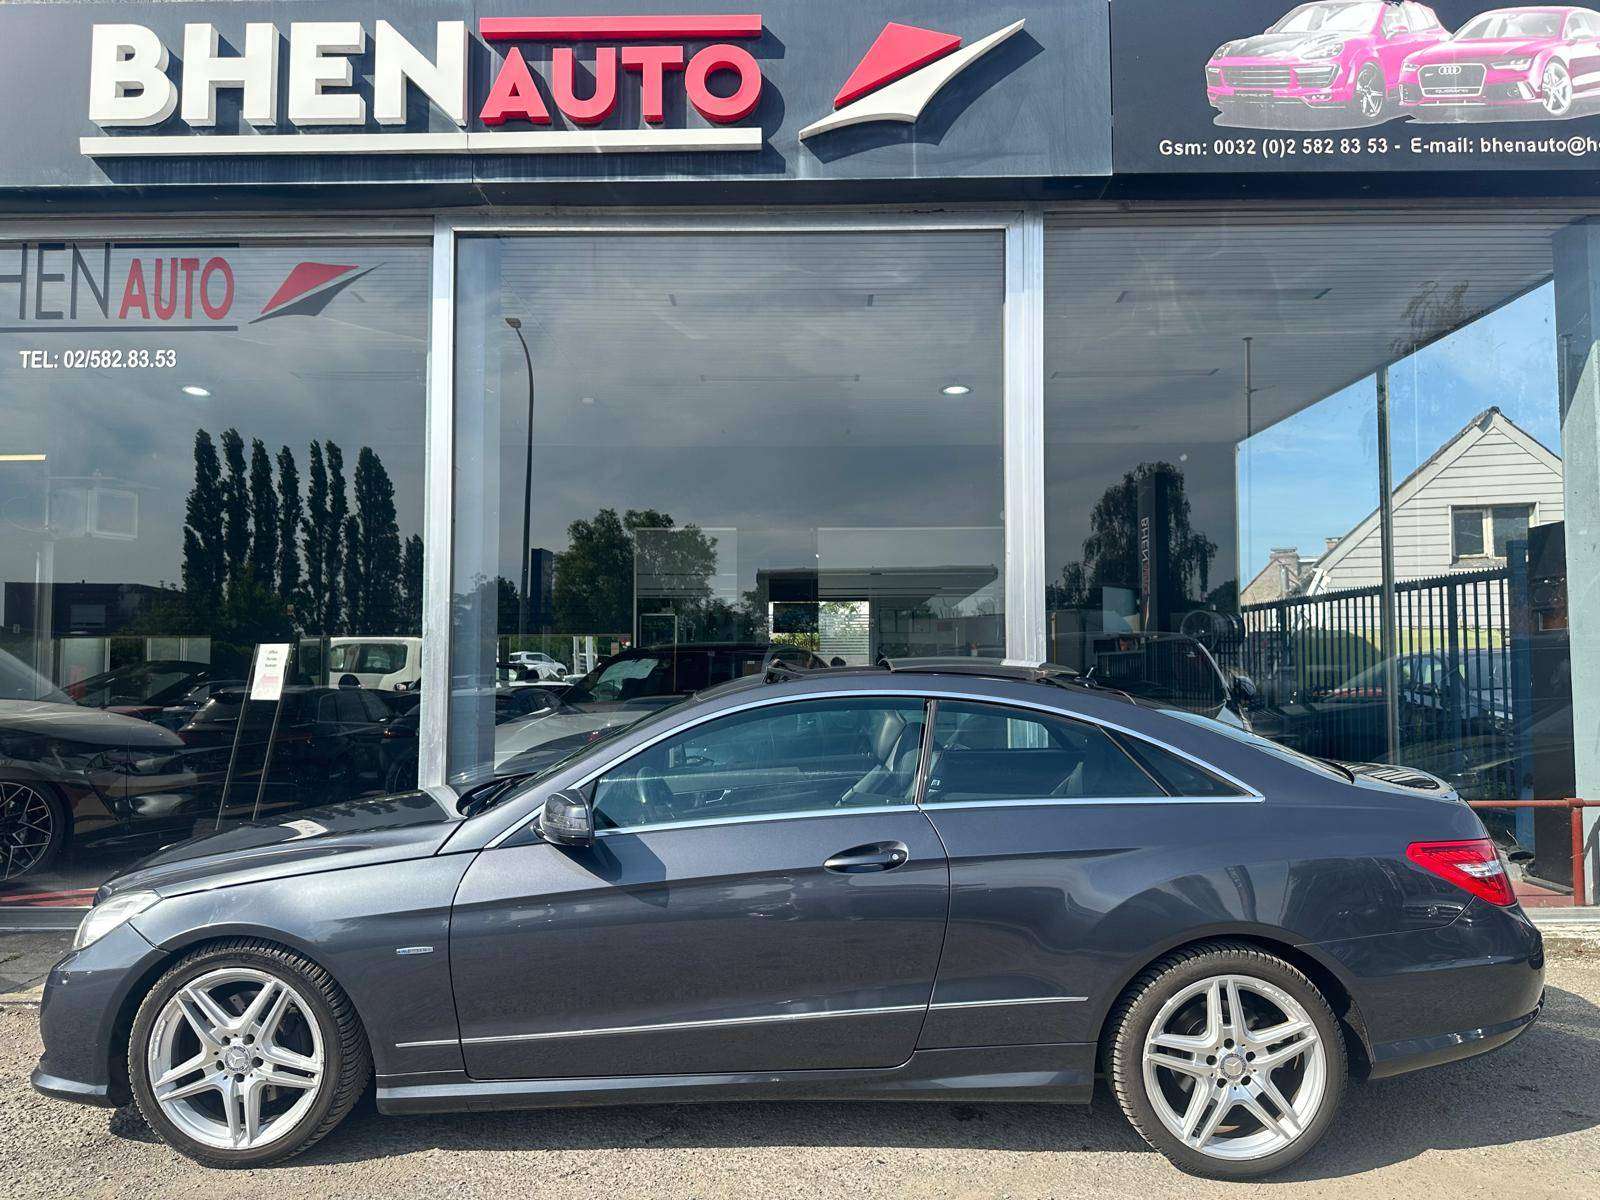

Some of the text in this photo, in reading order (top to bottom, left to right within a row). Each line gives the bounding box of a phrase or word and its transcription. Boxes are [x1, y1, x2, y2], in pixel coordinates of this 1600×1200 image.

[1159, 139, 1207, 157] Gsm:
[1213, 139, 1257, 156] 0032
[1262, 138, 1296, 159] (0)2
[1302, 138, 1334, 155] 582
[1339, 138, 1361, 154] 83
[1367, 137, 1388, 154] 53
[1410, 136, 1474, 154] E-mail:
[1480, 136, 1600, 157] bhenauto@h
[19, 349, 177, 369] TEL: 02/582.83.53
